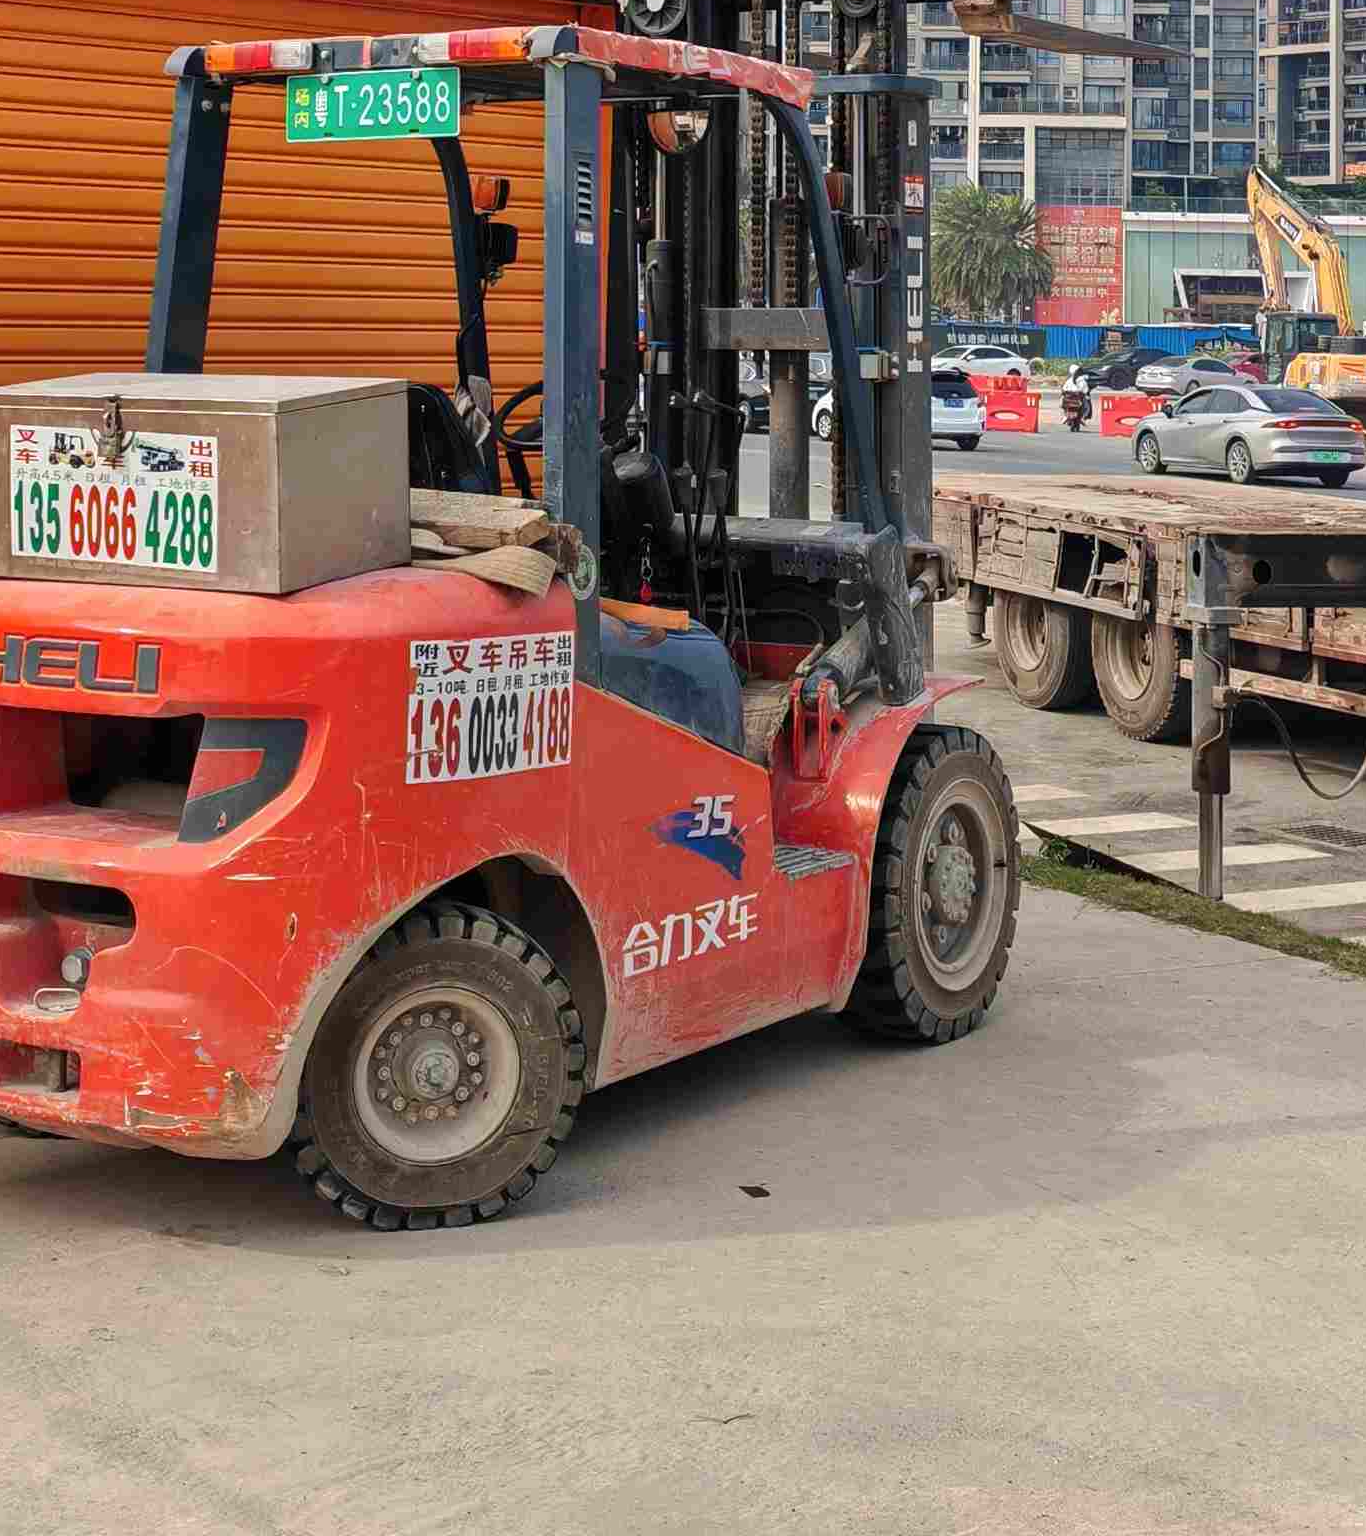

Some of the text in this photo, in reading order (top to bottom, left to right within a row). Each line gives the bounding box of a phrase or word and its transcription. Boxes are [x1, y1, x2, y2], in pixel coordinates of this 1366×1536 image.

[14, 428, 39, 465] 叉车
[187, 439, 214, 479] 出租
[14, 480, 214, 568] 135 6066 4288
[415, 634, 573, 679] 附近 叉车吊车 出租
[528, 669, 572, 688] 工地作业
[410, 686, 572, 779] 136 0033 4188
[686, 794, 736, 839] 35
[621, 892, 759, 978] 合力叉车
